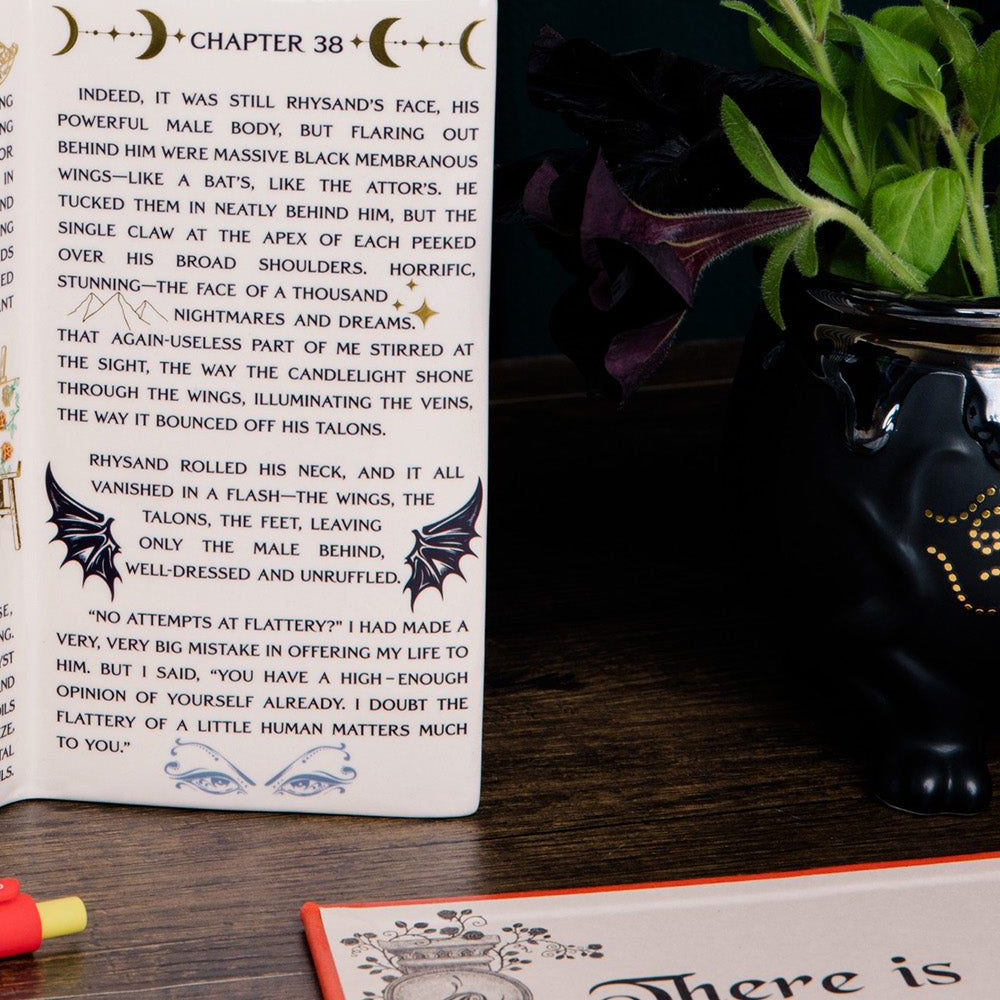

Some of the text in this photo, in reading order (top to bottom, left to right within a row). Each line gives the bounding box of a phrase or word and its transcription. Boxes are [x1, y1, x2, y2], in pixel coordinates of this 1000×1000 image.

[190, 31, 344, 54] CHAPTER 38
[58, 113, 479, 142] POWERFUL MALE BODY, BUT FLARING OUT
[58, 140, 478, 169] BEHIND HIM WERE MASSIVE BLACK MEMBRANOUS
[58, 194, 477, 224] TUCKED THEM IN NEATLY BEHIND HIM, BUT THE
[58, 221, 476, 250] SINGLE CLAW AT THE APEX OF EACH PEEKED
[58, 248, 476, 278] OVER HIS BROAD SHOULDERS. HORRIFIC,
[57, 354, 474, 384] THE SIGHT, THE WAY THE CANDLELIGHT SHONE
[57, 381, 473, 410] THROUGH THE WINGS, ILLUMINATING THE VEINS,
[56, 407, 386, 436] THE WAY IT BOUNCED OFF HIS TALONS.
[90, 453, 464, 480] RHYSAND ROLLED HIS NECK, AND IT ALL
[142, 509, 382, 532] TALONS, THE FEET, LEAVING
[138, 536, 385, 560] ONLY THE MALE BEHIND,
[56, 710, 468, 737] FLATTERY OF A LITTLE HUMAN MATTERS MUCH
[588, 956, 962, 1000] There is
